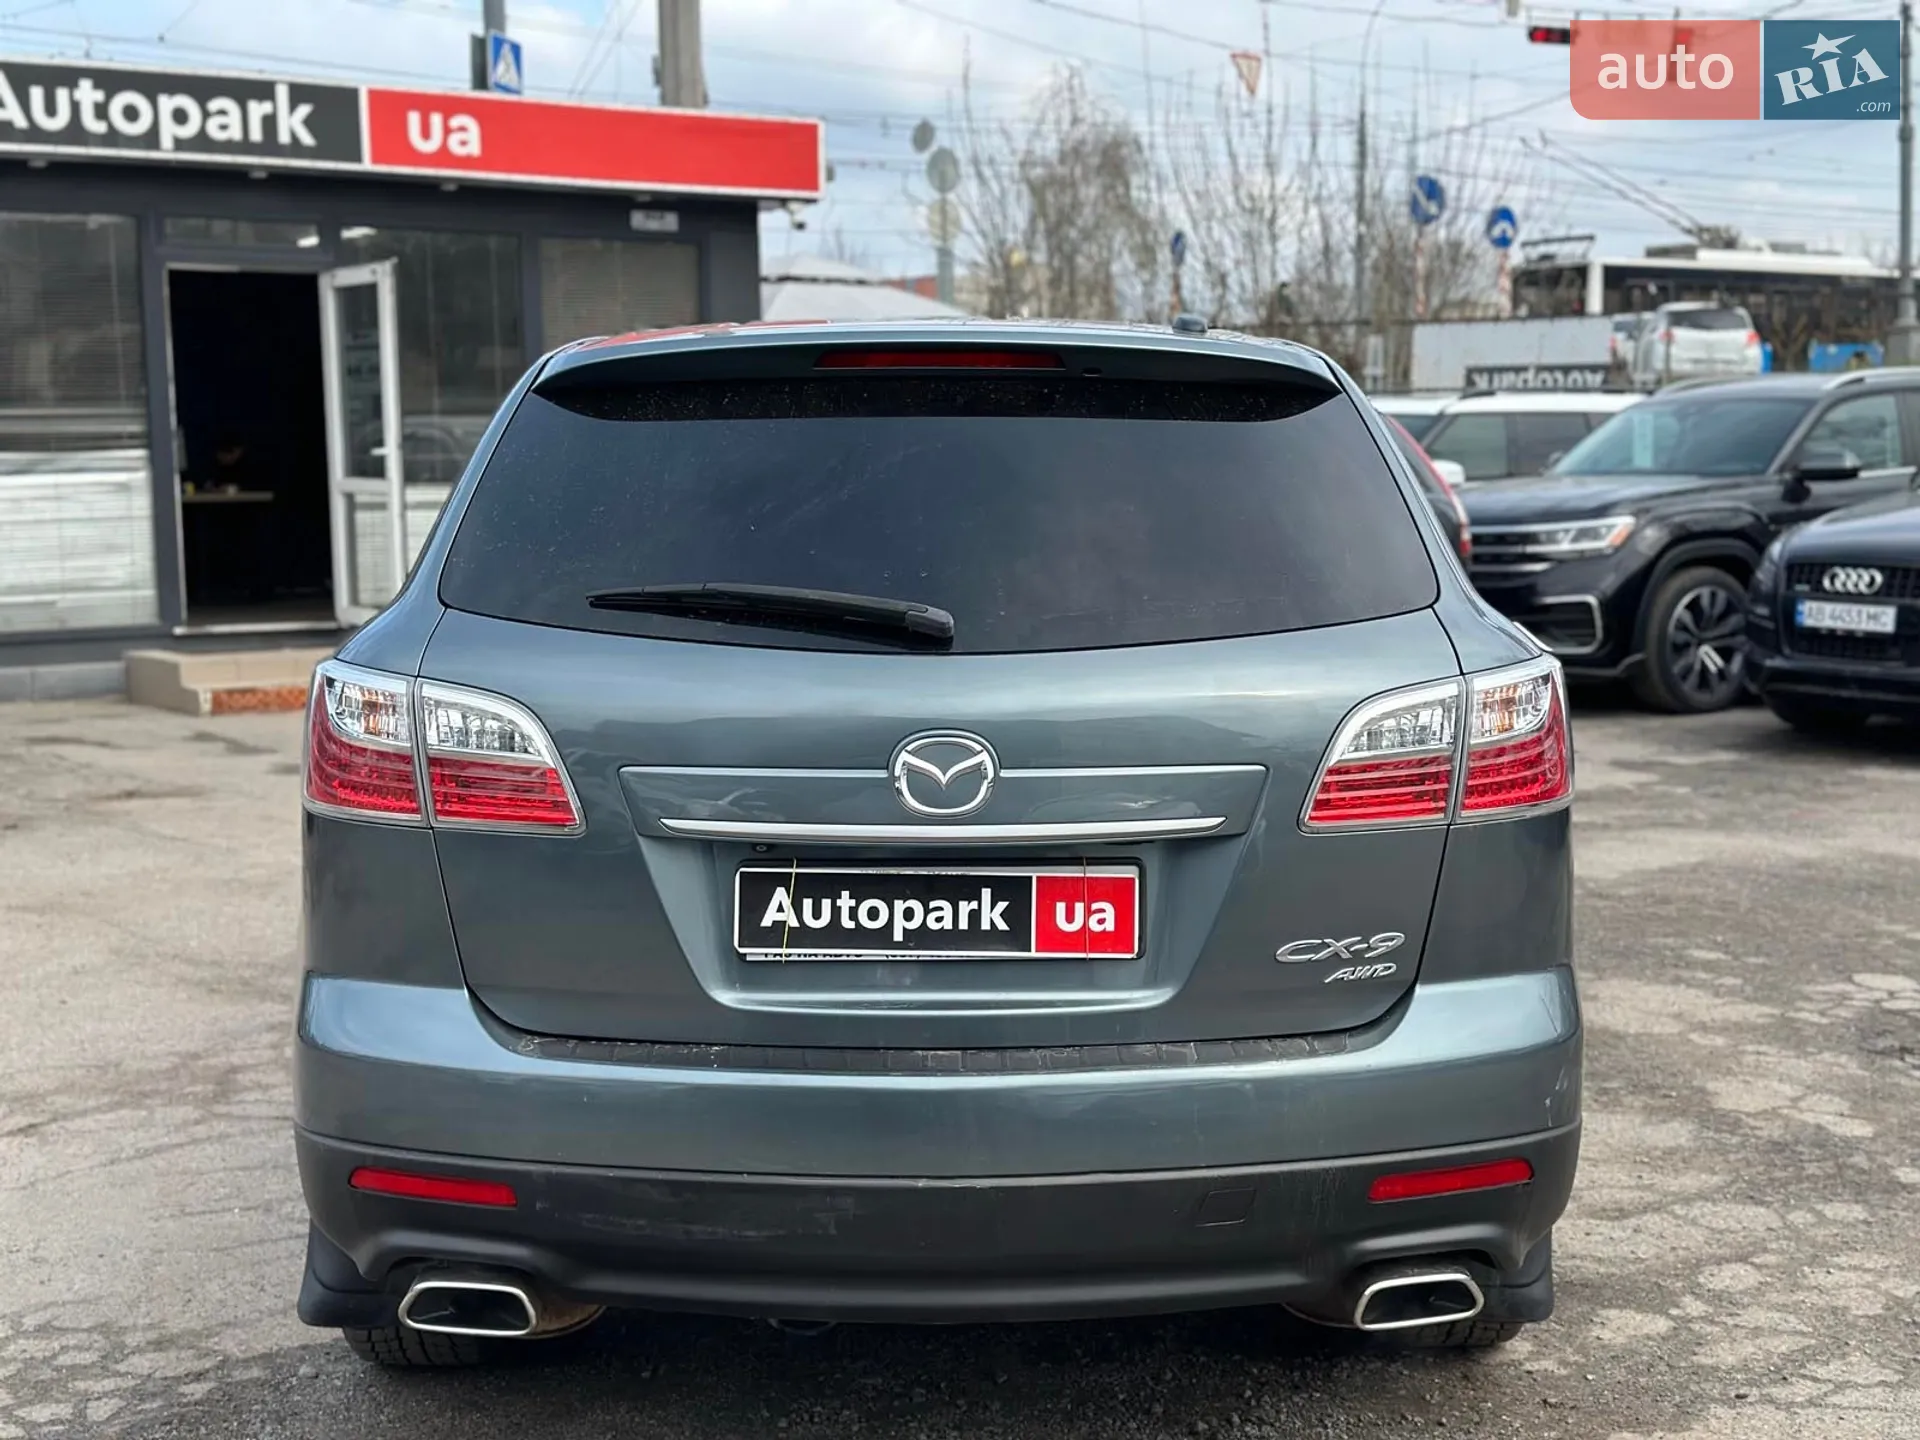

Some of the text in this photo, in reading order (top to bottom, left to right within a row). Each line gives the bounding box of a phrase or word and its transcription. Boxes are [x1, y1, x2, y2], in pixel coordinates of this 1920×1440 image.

[406, 109, 482, 158] ua
[760, 886, 1116, 942] Autopark ua
[1275, 932, 1405, 963] CX-9
[1324, 962, 1397, 983] AWD
